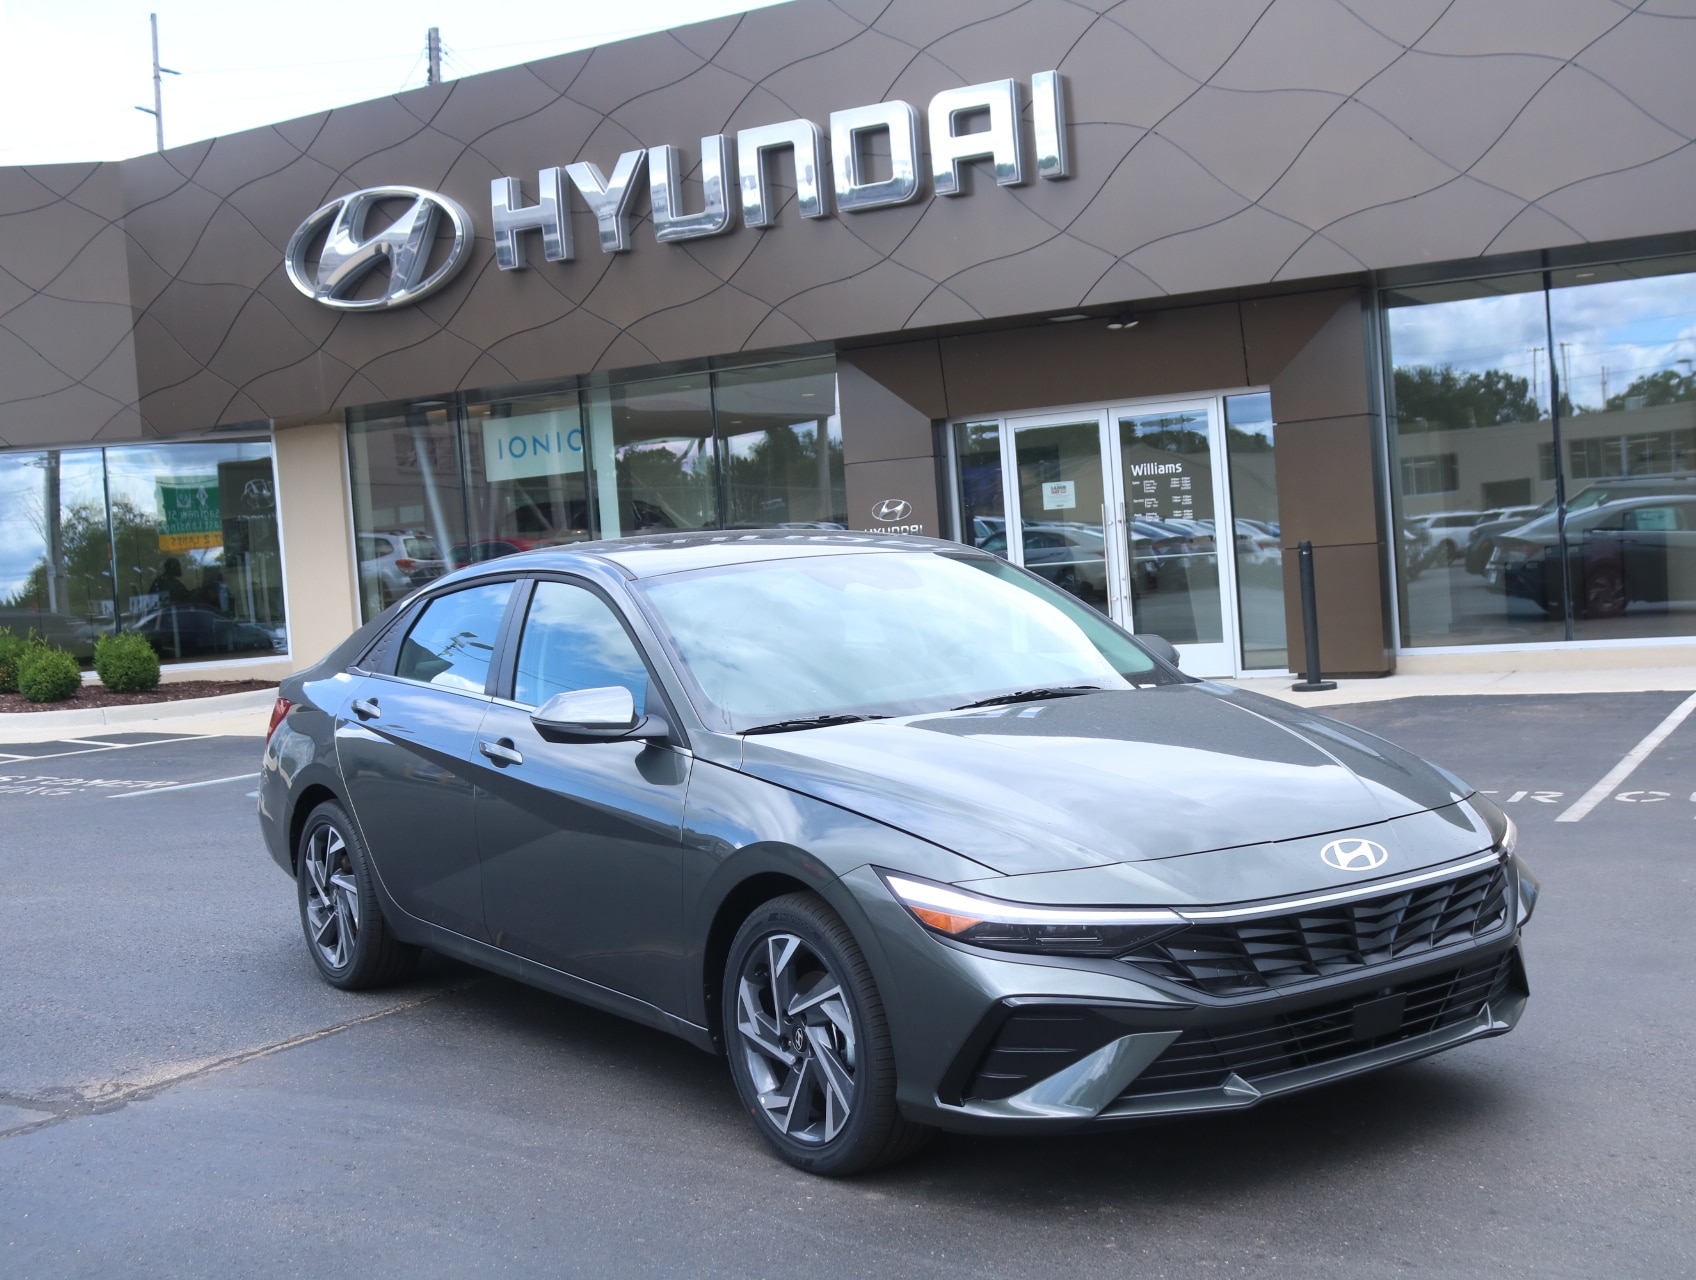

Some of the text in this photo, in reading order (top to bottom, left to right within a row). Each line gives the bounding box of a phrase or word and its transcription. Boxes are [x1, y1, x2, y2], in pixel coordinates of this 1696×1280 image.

[490, 69, 1071, 271] HYUNDAI
[1130, 462, 1182, 477] Williams
[864, 524, 923, 535] UNDAI
